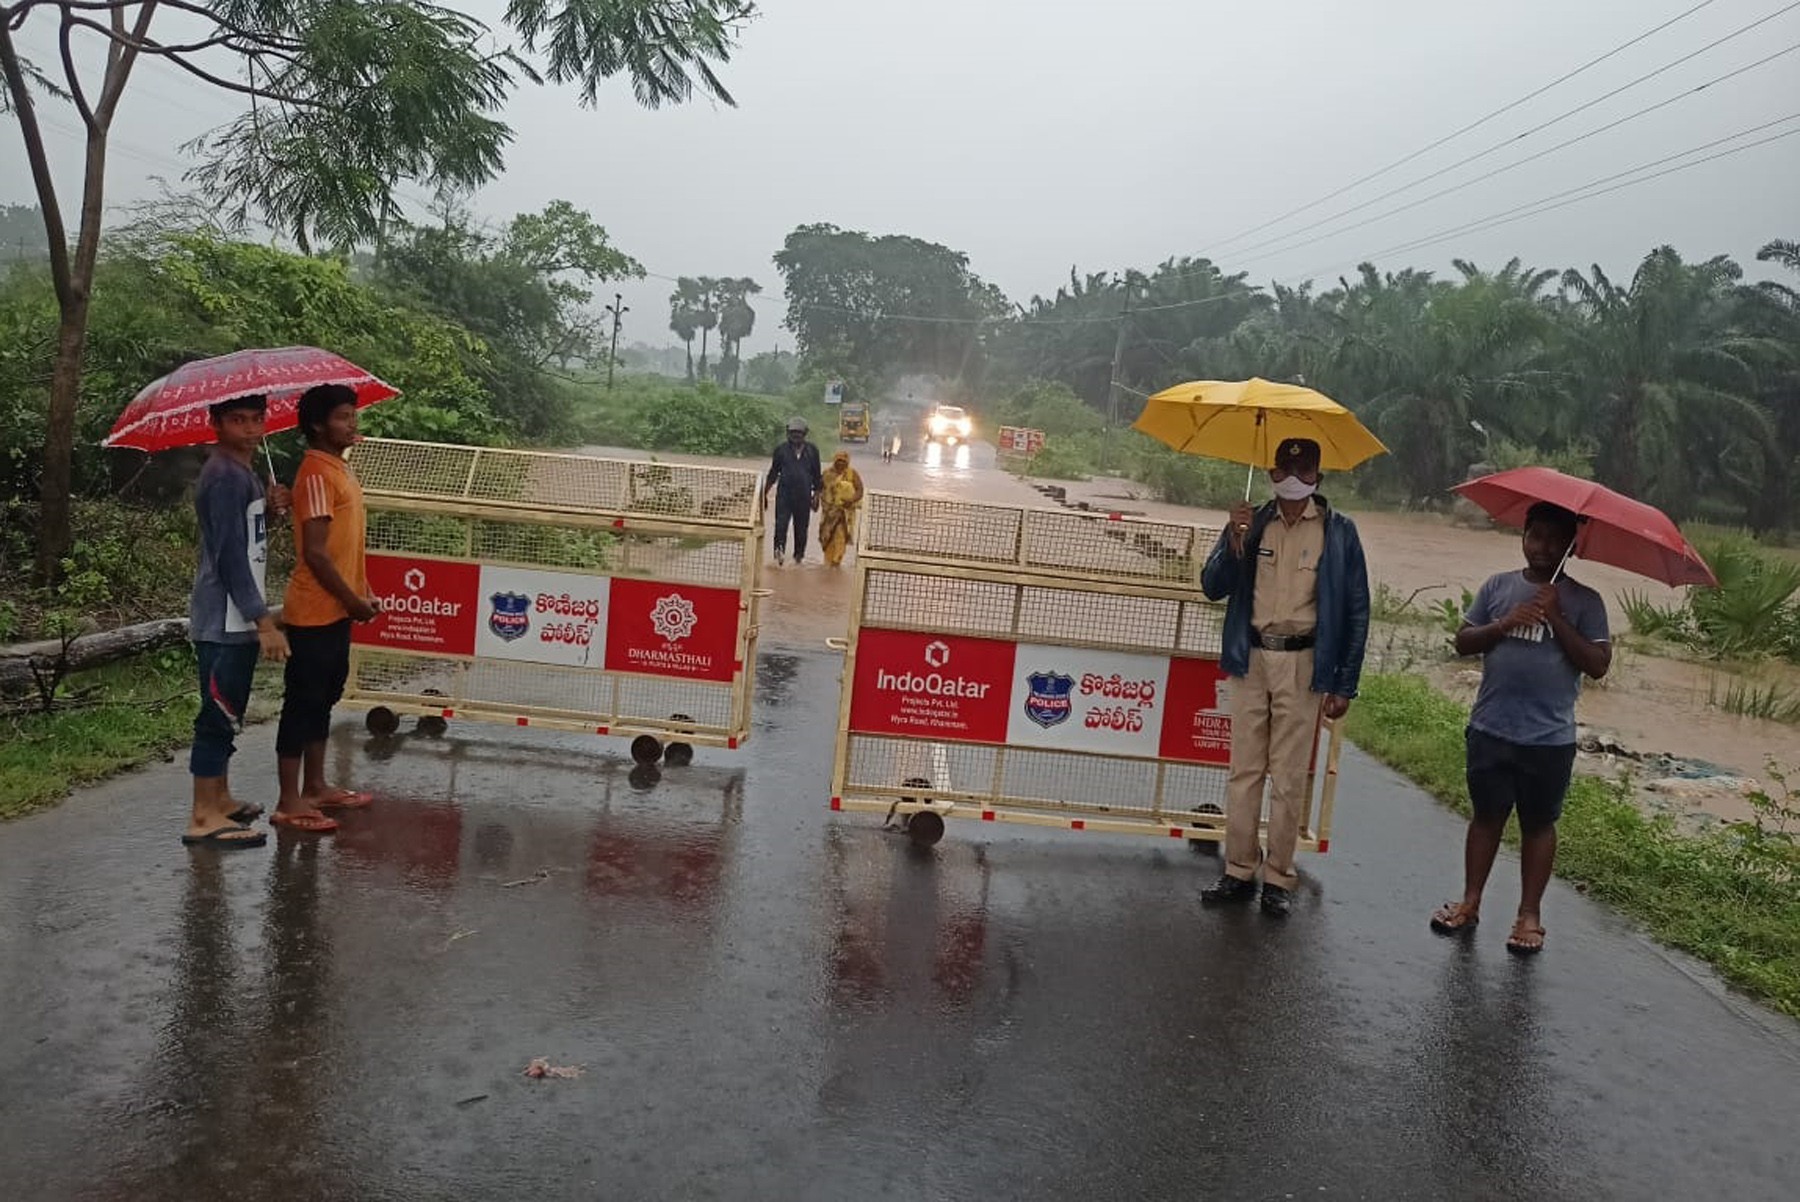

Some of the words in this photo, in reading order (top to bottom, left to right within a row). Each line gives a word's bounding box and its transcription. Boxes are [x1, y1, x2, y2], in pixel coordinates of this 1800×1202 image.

[376, 594, 462, 616] ndoQatar
[877, 668, 991, 698] IndoQatar
[1029, 697, 1069, 708] POLICE
